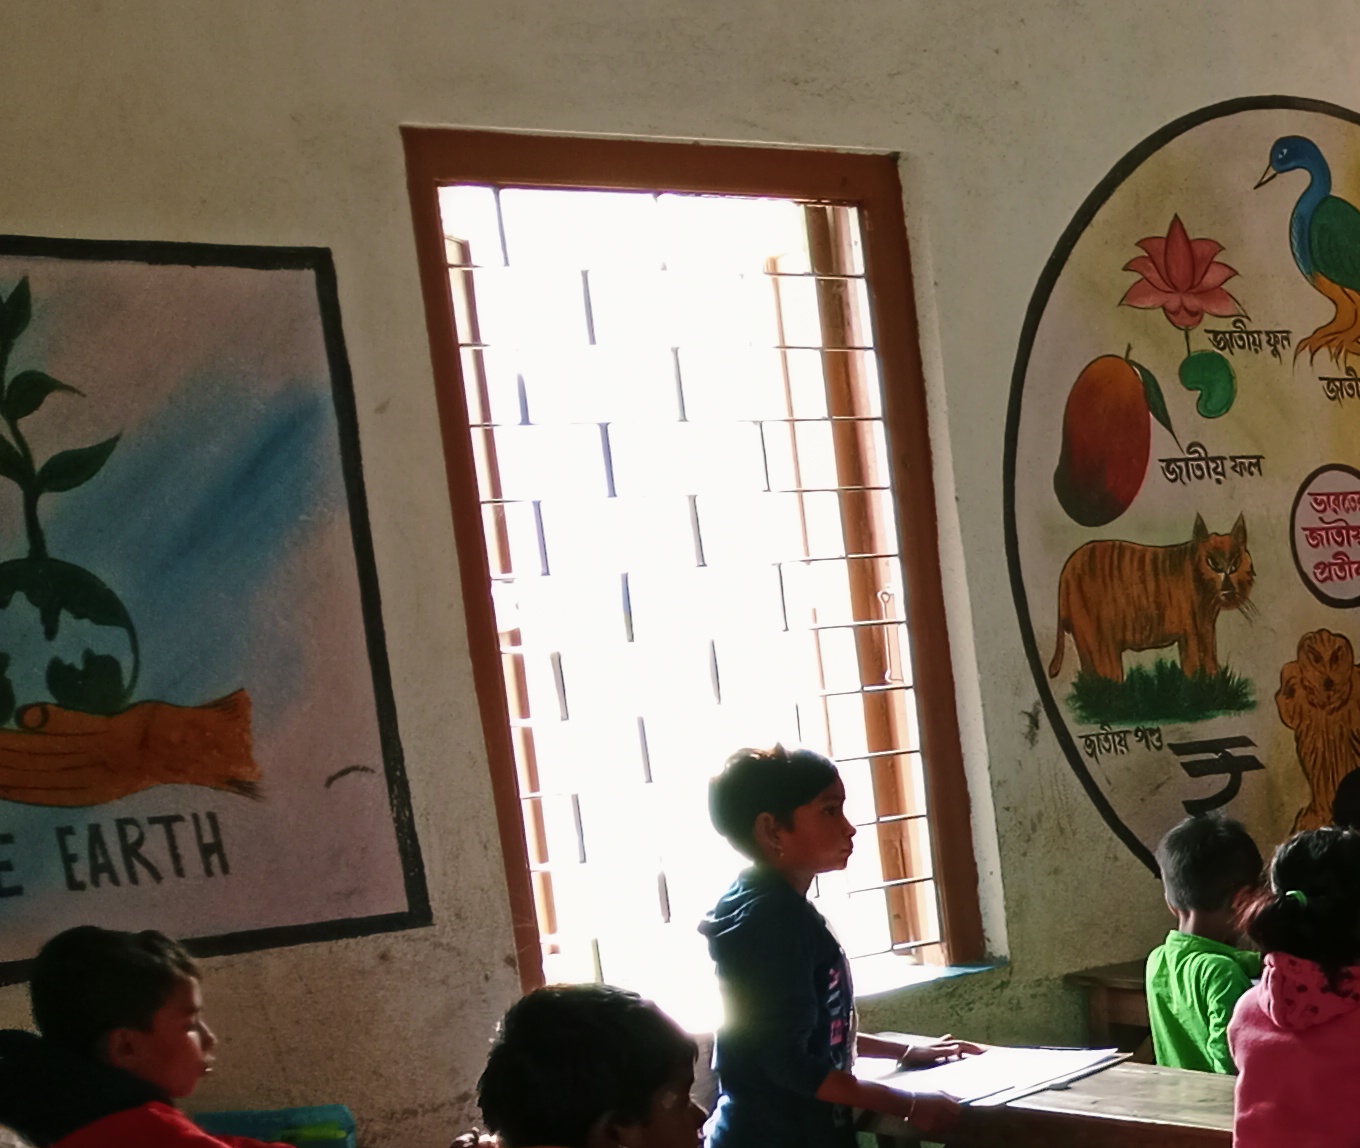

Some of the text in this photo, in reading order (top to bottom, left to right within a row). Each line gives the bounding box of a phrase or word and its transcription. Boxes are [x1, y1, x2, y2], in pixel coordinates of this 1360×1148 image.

[1204, 318, 1263, 356] জাতীয়
[1158, 441, 1265, 485] জাতীয় ফল
[1078, 723, 1132, 765] জাতীয়
[54, 810, 230, 892] EARTH
